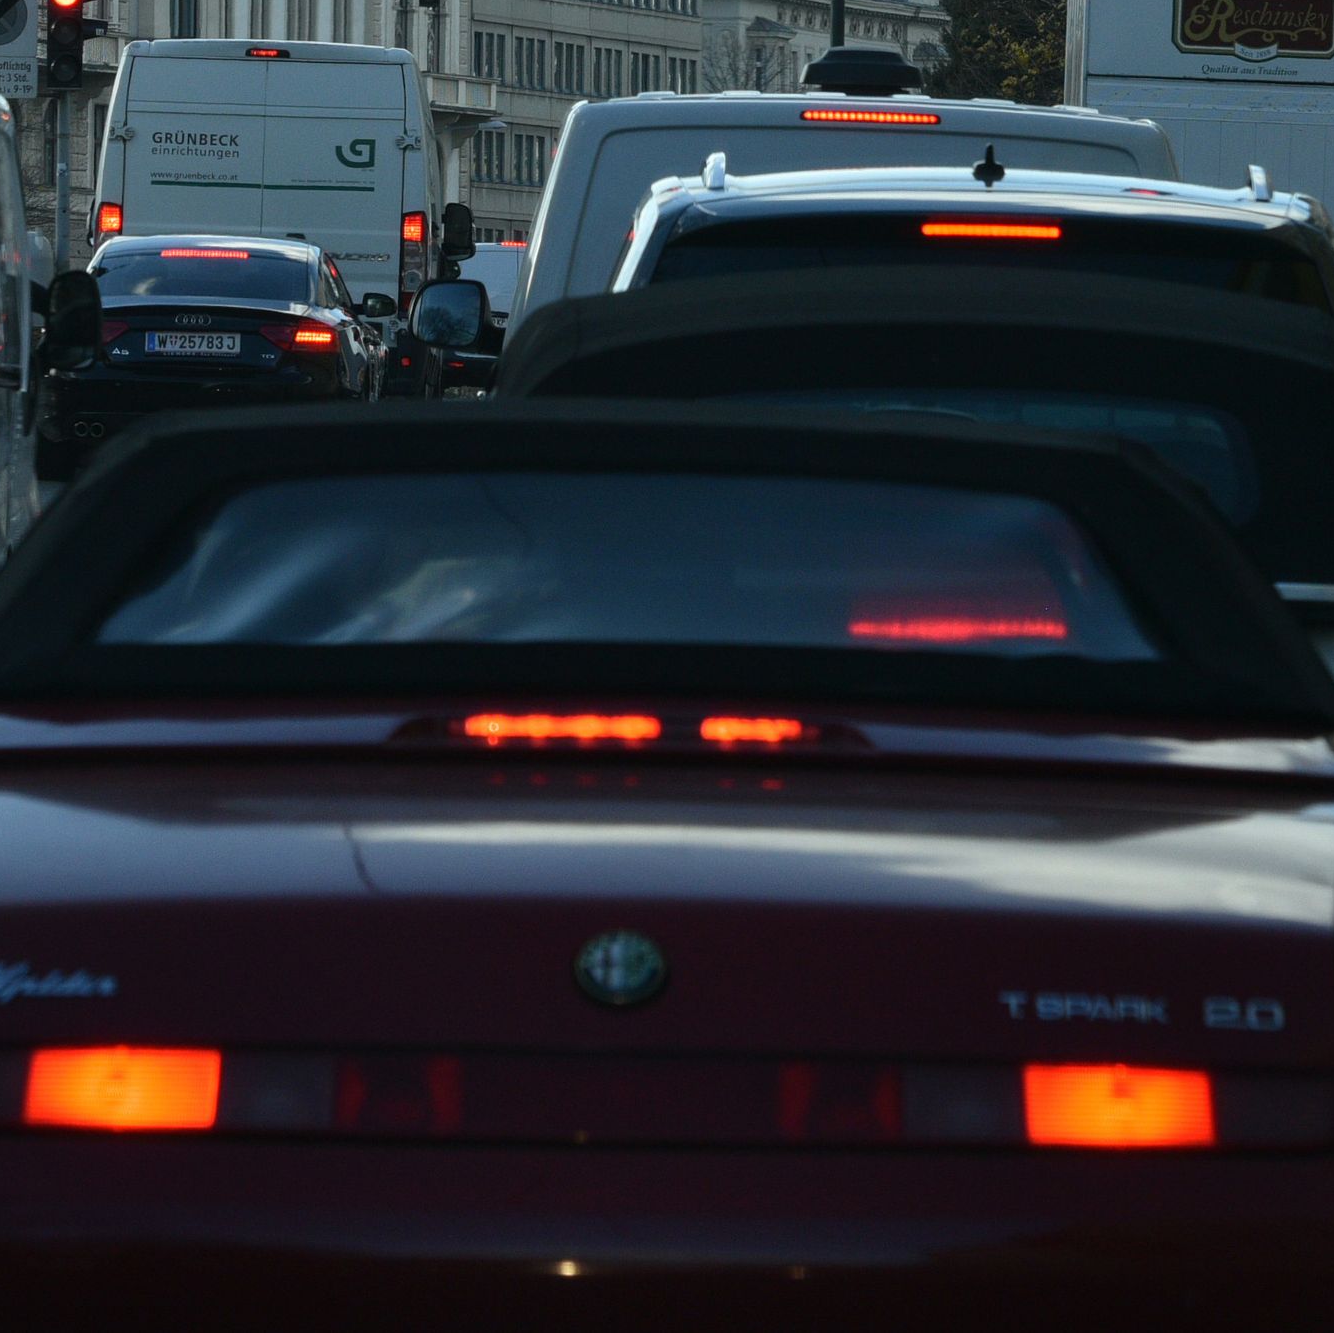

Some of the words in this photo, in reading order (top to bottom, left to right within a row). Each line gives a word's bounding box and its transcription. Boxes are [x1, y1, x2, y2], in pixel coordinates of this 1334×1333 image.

[1201, 64, 1238, 76] Qualität
[1240, 67, 1256, 76] aus
[1258, 66, 1299, 77] Tradition
[152, 130, 239, 147] GRÜNBECK
[151, 145, 240, 160] einrichtungen
[150, 171, 238, 181] www.gruenbeck.co.at
